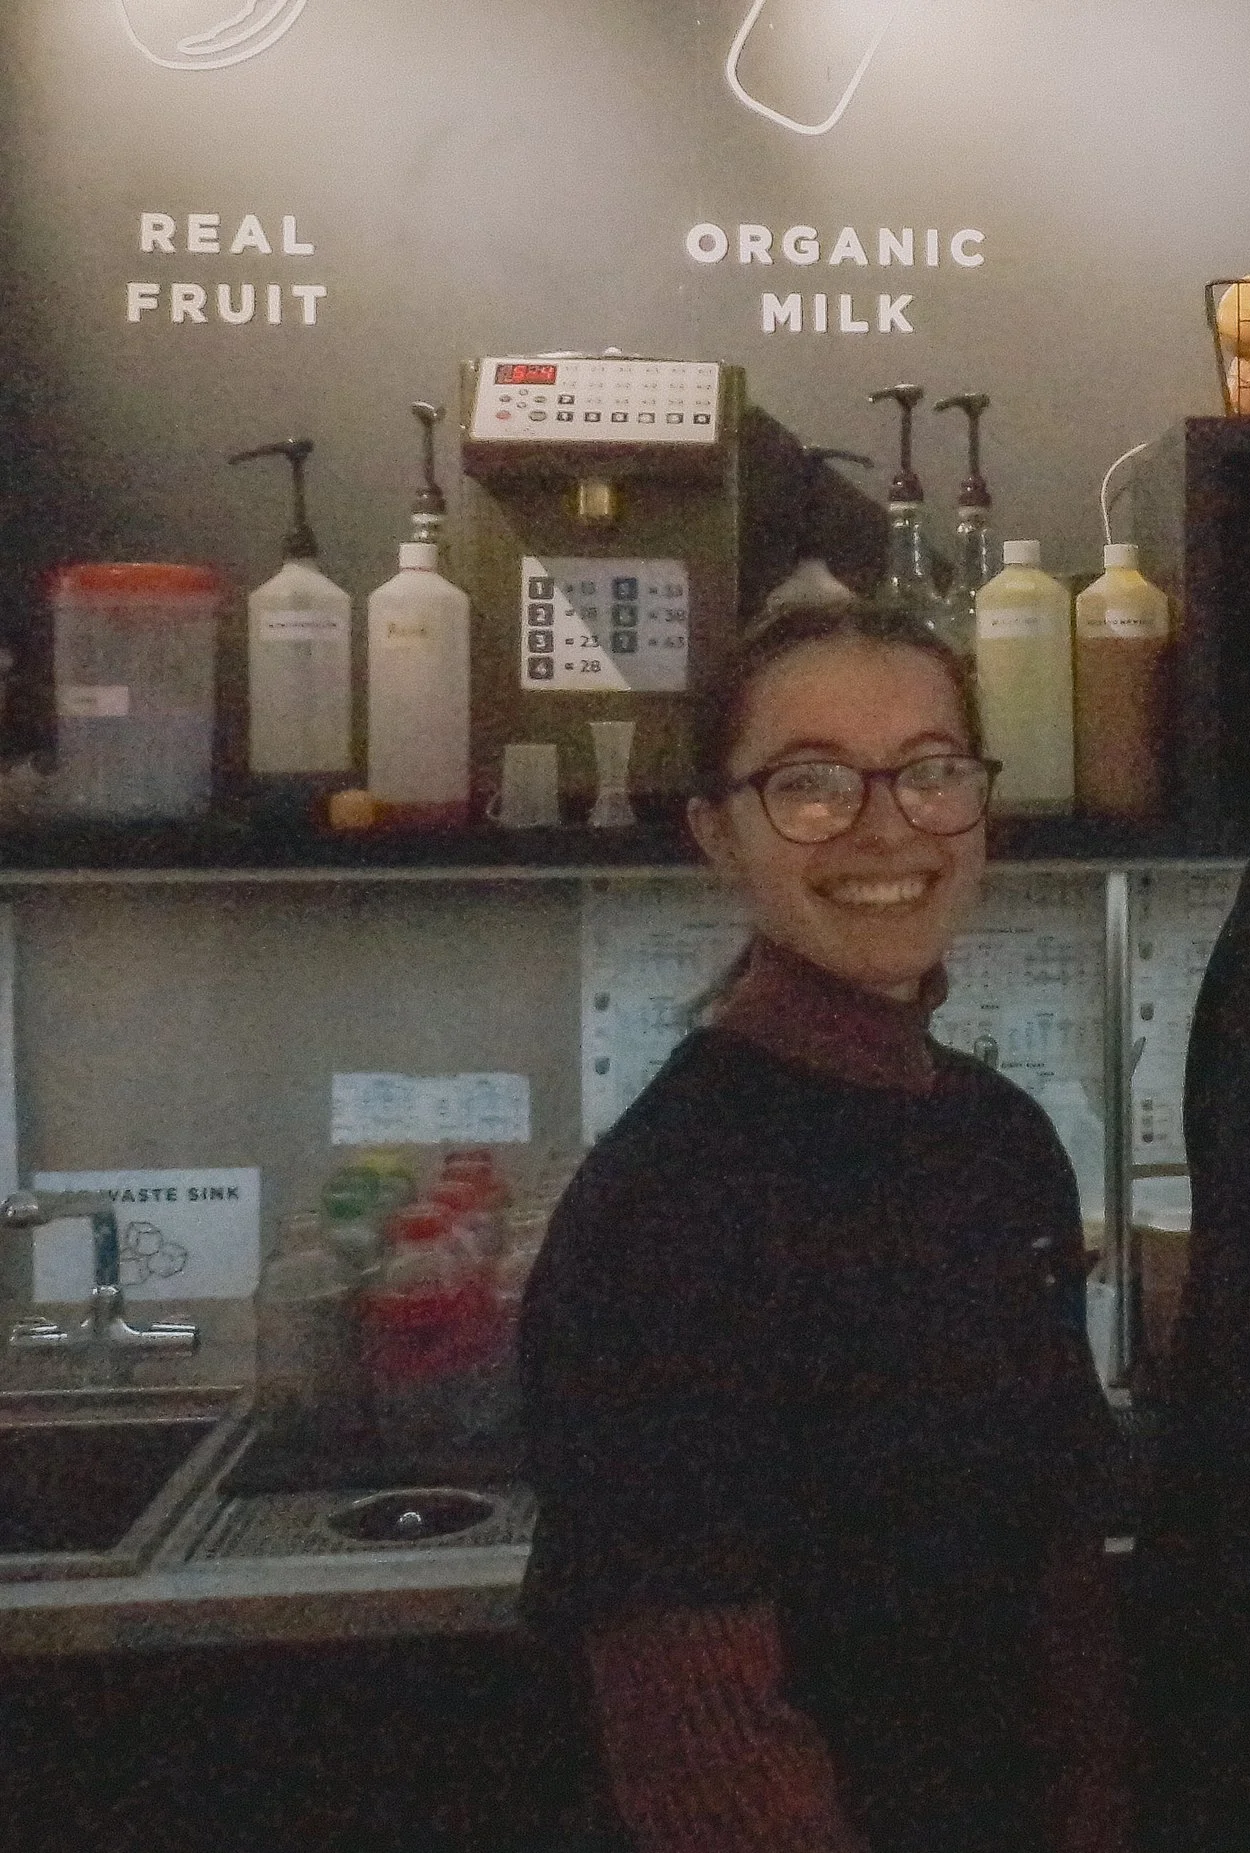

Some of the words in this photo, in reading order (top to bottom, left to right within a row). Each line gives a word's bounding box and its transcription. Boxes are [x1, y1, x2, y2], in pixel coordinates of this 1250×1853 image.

[140, 213, 314, 255] REAL
[685, 223, 985, 267] ORGANIC
[126, 282, 328, 325] FRUIT
[761, 292, 914, 334] MILK
[580, 660, 602, 673] 28
[187, 1186, 240, 1202] SINK
